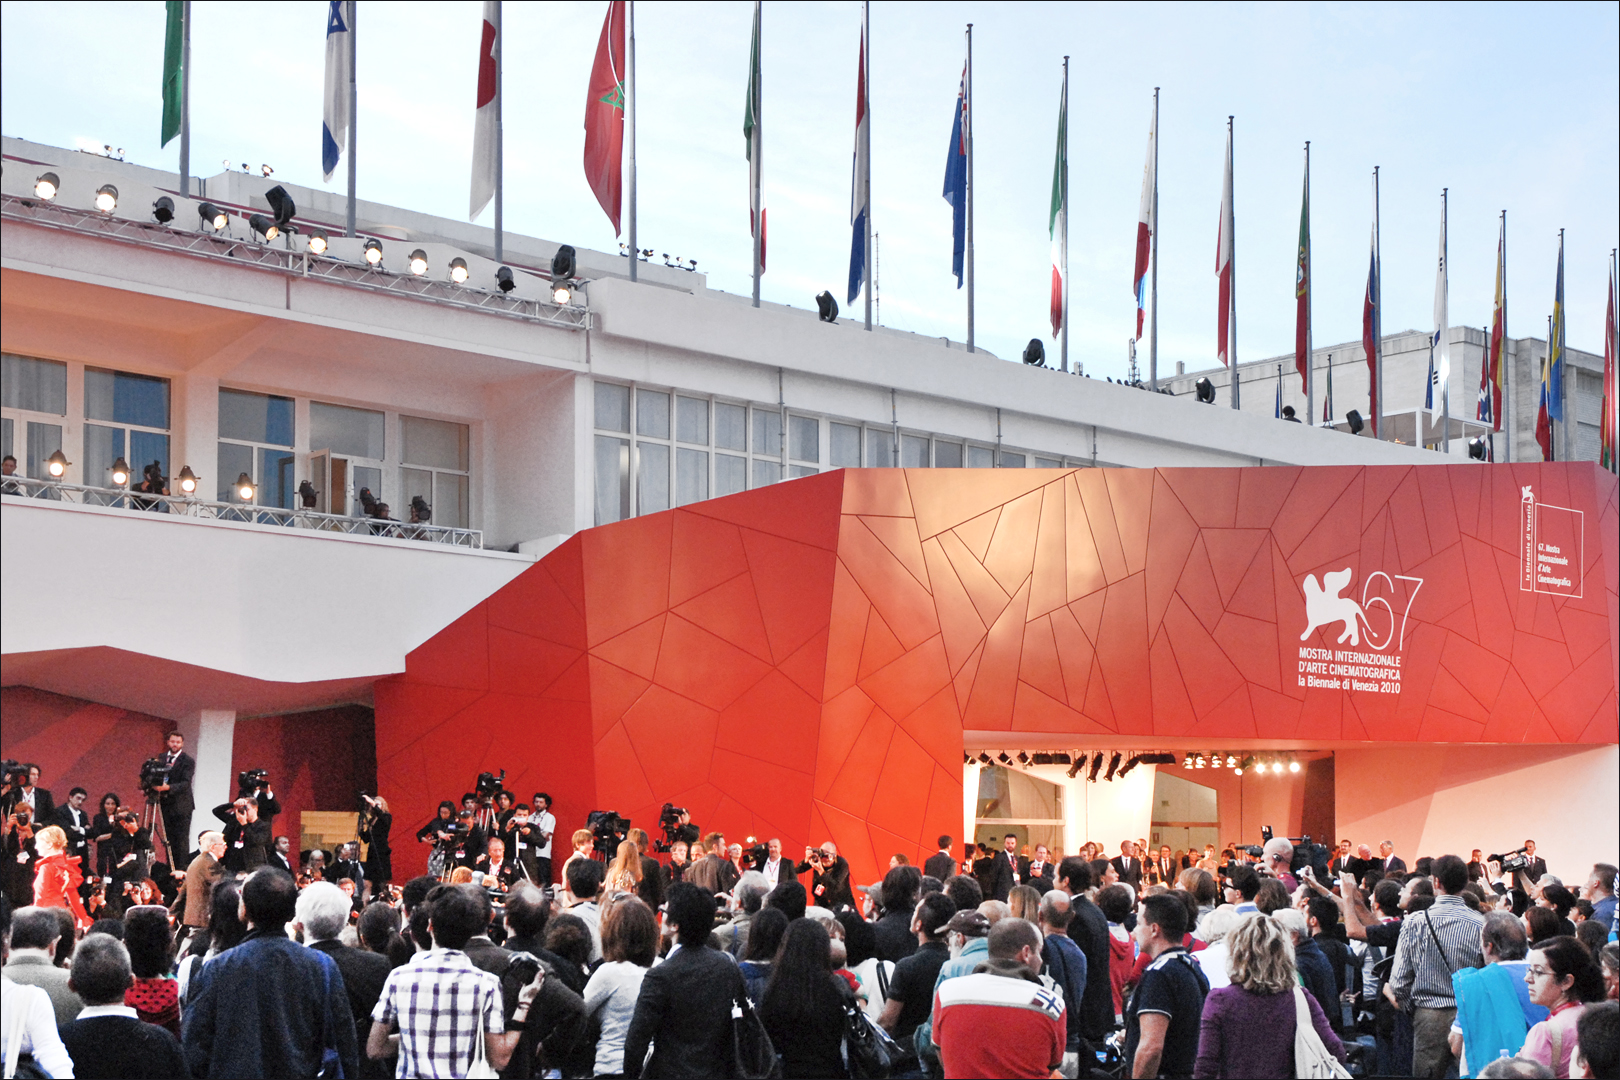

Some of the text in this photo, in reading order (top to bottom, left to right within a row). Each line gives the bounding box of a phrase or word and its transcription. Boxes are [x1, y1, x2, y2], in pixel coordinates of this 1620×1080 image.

[1546, 544, 1560, 554] Mostra
[1538, 553, 1568, 566] Internazionale
[1538, 563, 1551, 574] d'Arte
[1538, 574, 1571, 587] Cinematografica
[1363, 571, 1423, 651] 67
[1299, 647, 1401, 667] MOSTRA INTERNAZIONALE
[1298, 661, 1400, 680] D'ARTE CINEMATOGRAFICA
[1298, 674, 1400, 694] la Biennale di Venezia 2010
